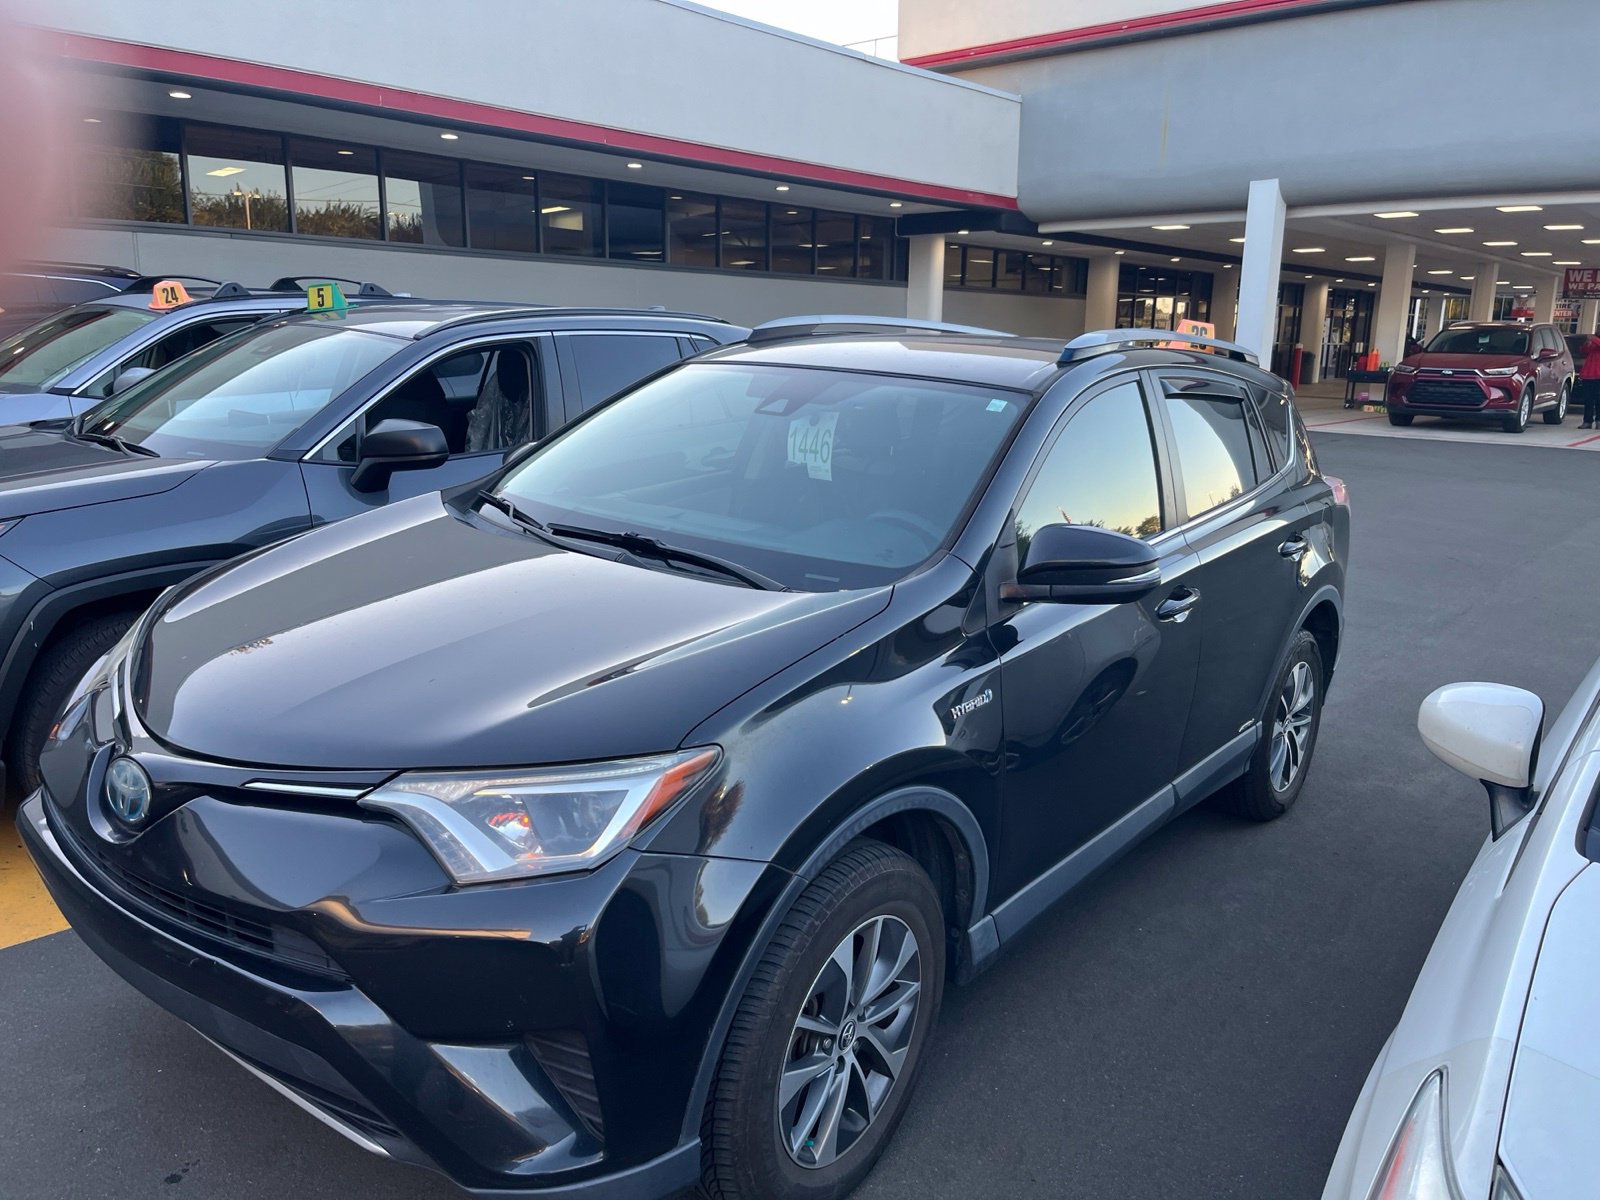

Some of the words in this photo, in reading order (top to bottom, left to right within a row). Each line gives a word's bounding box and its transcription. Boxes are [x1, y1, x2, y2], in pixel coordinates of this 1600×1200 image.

[1568, 270, 1593, 282] WE
[162, 286, 178, 304] 24
[1568, 282, 1584, 290] WE
[1587, 282, 1600, 290] PA
[317, 288, 325, 308] 5
[790, 427, 831, 464] 1446
[951, 694, 988, 719] HYBRID
